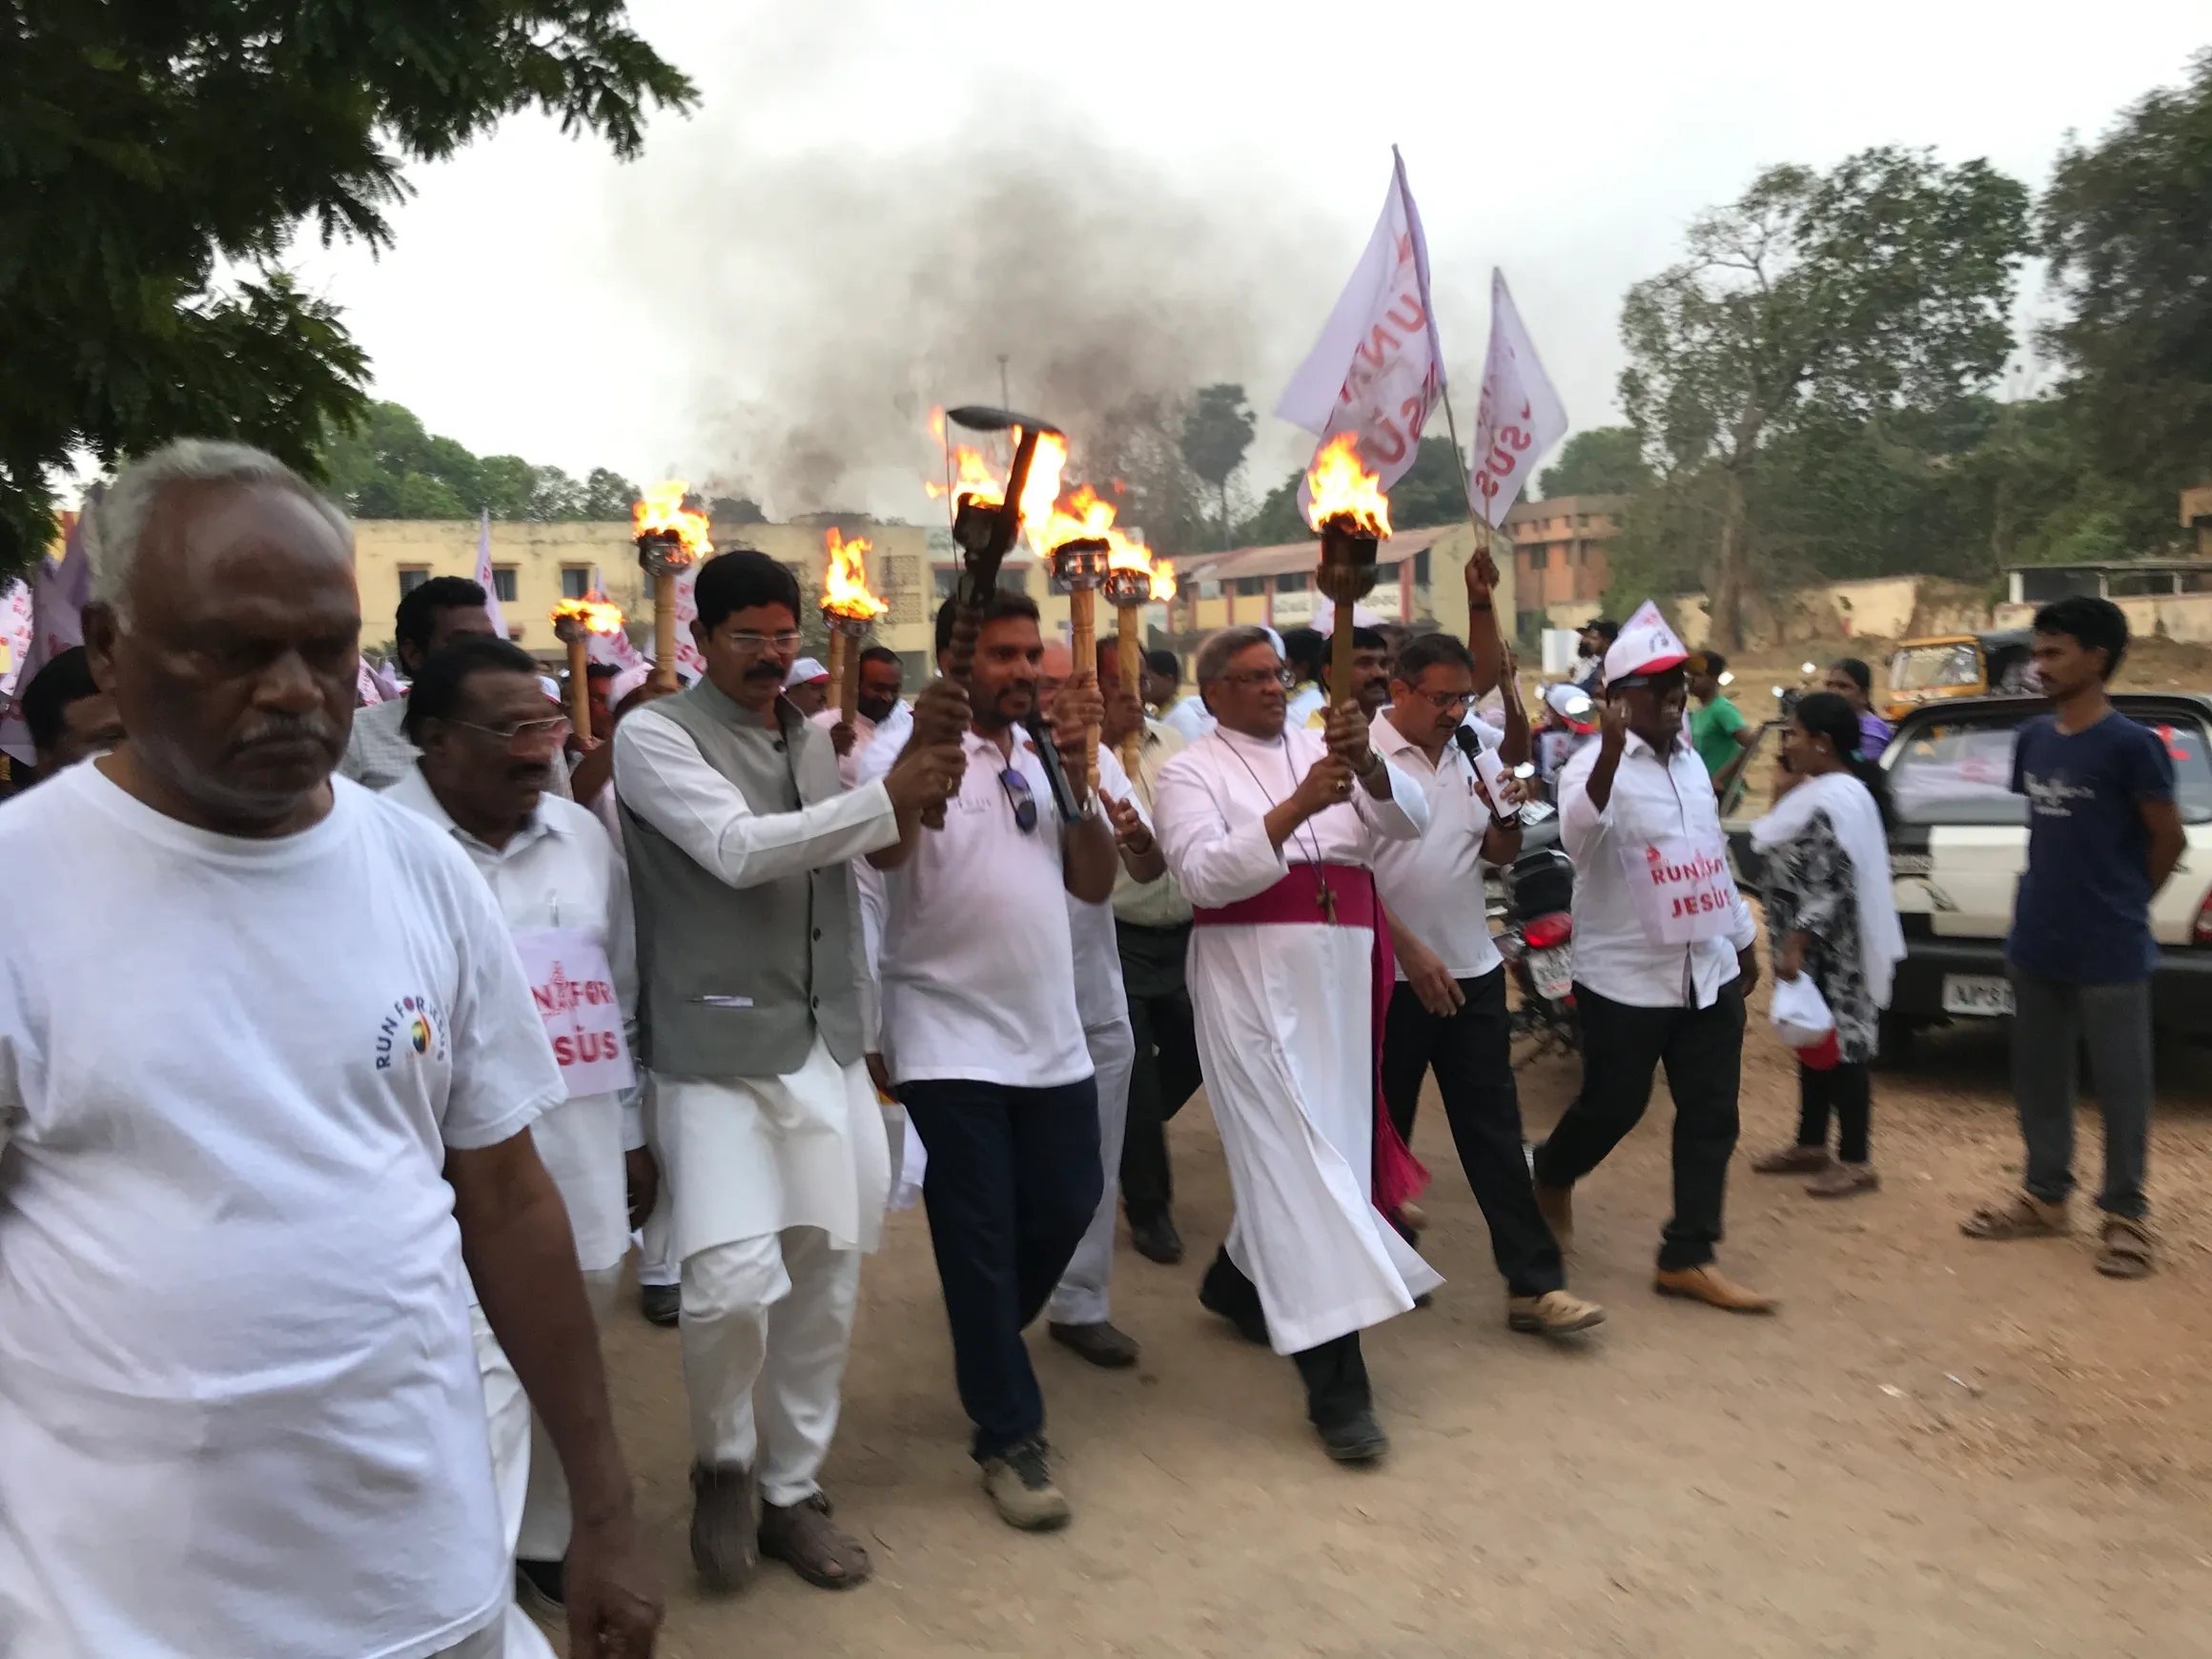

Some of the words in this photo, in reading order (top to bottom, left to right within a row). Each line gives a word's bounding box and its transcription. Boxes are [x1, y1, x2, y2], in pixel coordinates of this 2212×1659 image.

[1650, 861, 1699, 885] RUN
[377, 1016, 398, 1070] RUN
[394, 995, 424, 1018] FOR
[554, 1030, 619, 1066] SUS
